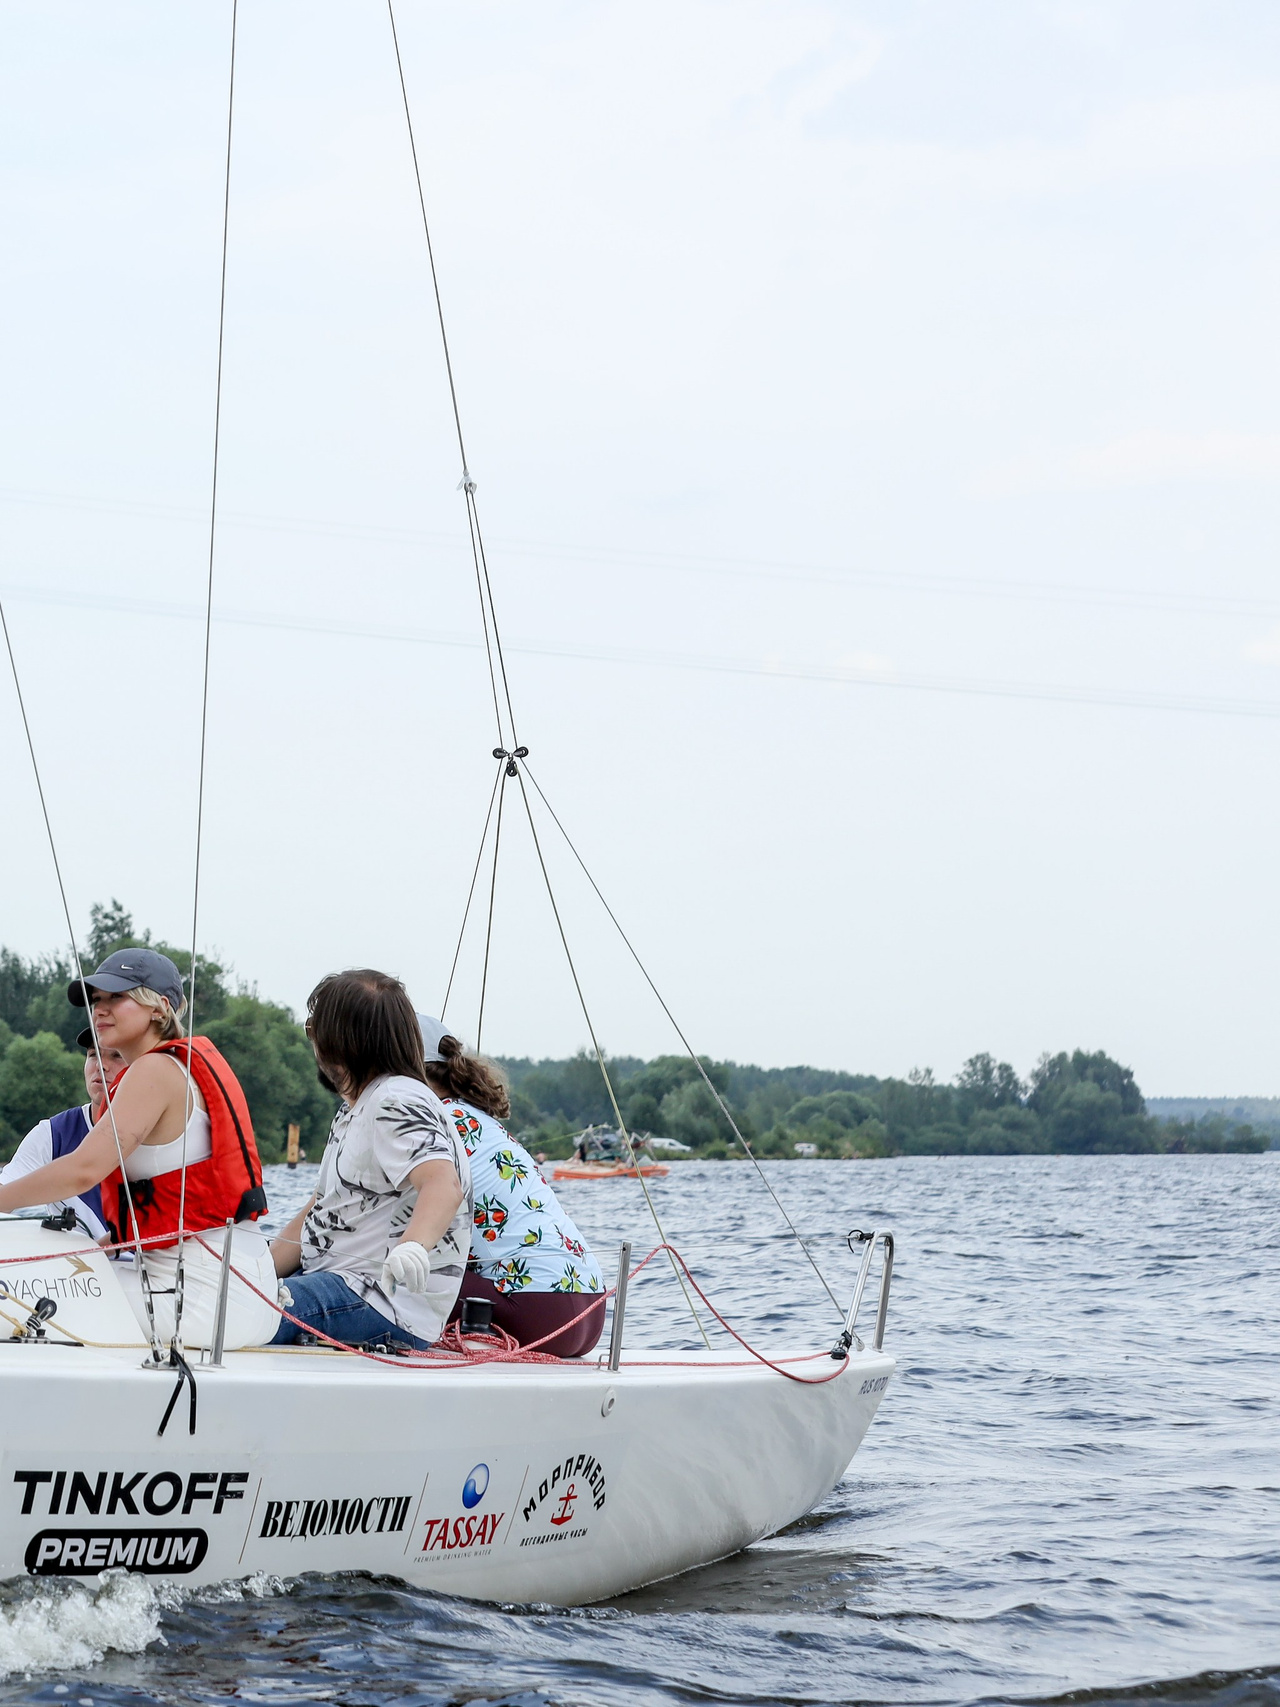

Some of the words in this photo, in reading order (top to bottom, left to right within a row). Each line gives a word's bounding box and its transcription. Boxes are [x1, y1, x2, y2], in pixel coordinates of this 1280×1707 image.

[13, 1470, 250, 1516] TINKOFF
[522, 1453, 606, 1523] МОРПРИБОР
[258, 1495, 413, 1543] ВЕДОМОСТИ
[421, 1512, 505, 1551] TASSAY
[35, 1536, 199, 1567] PREMIUM
[413, 1556, 441, 1564] PREMIUM
[473, 1548, 492, 1556] WATER
